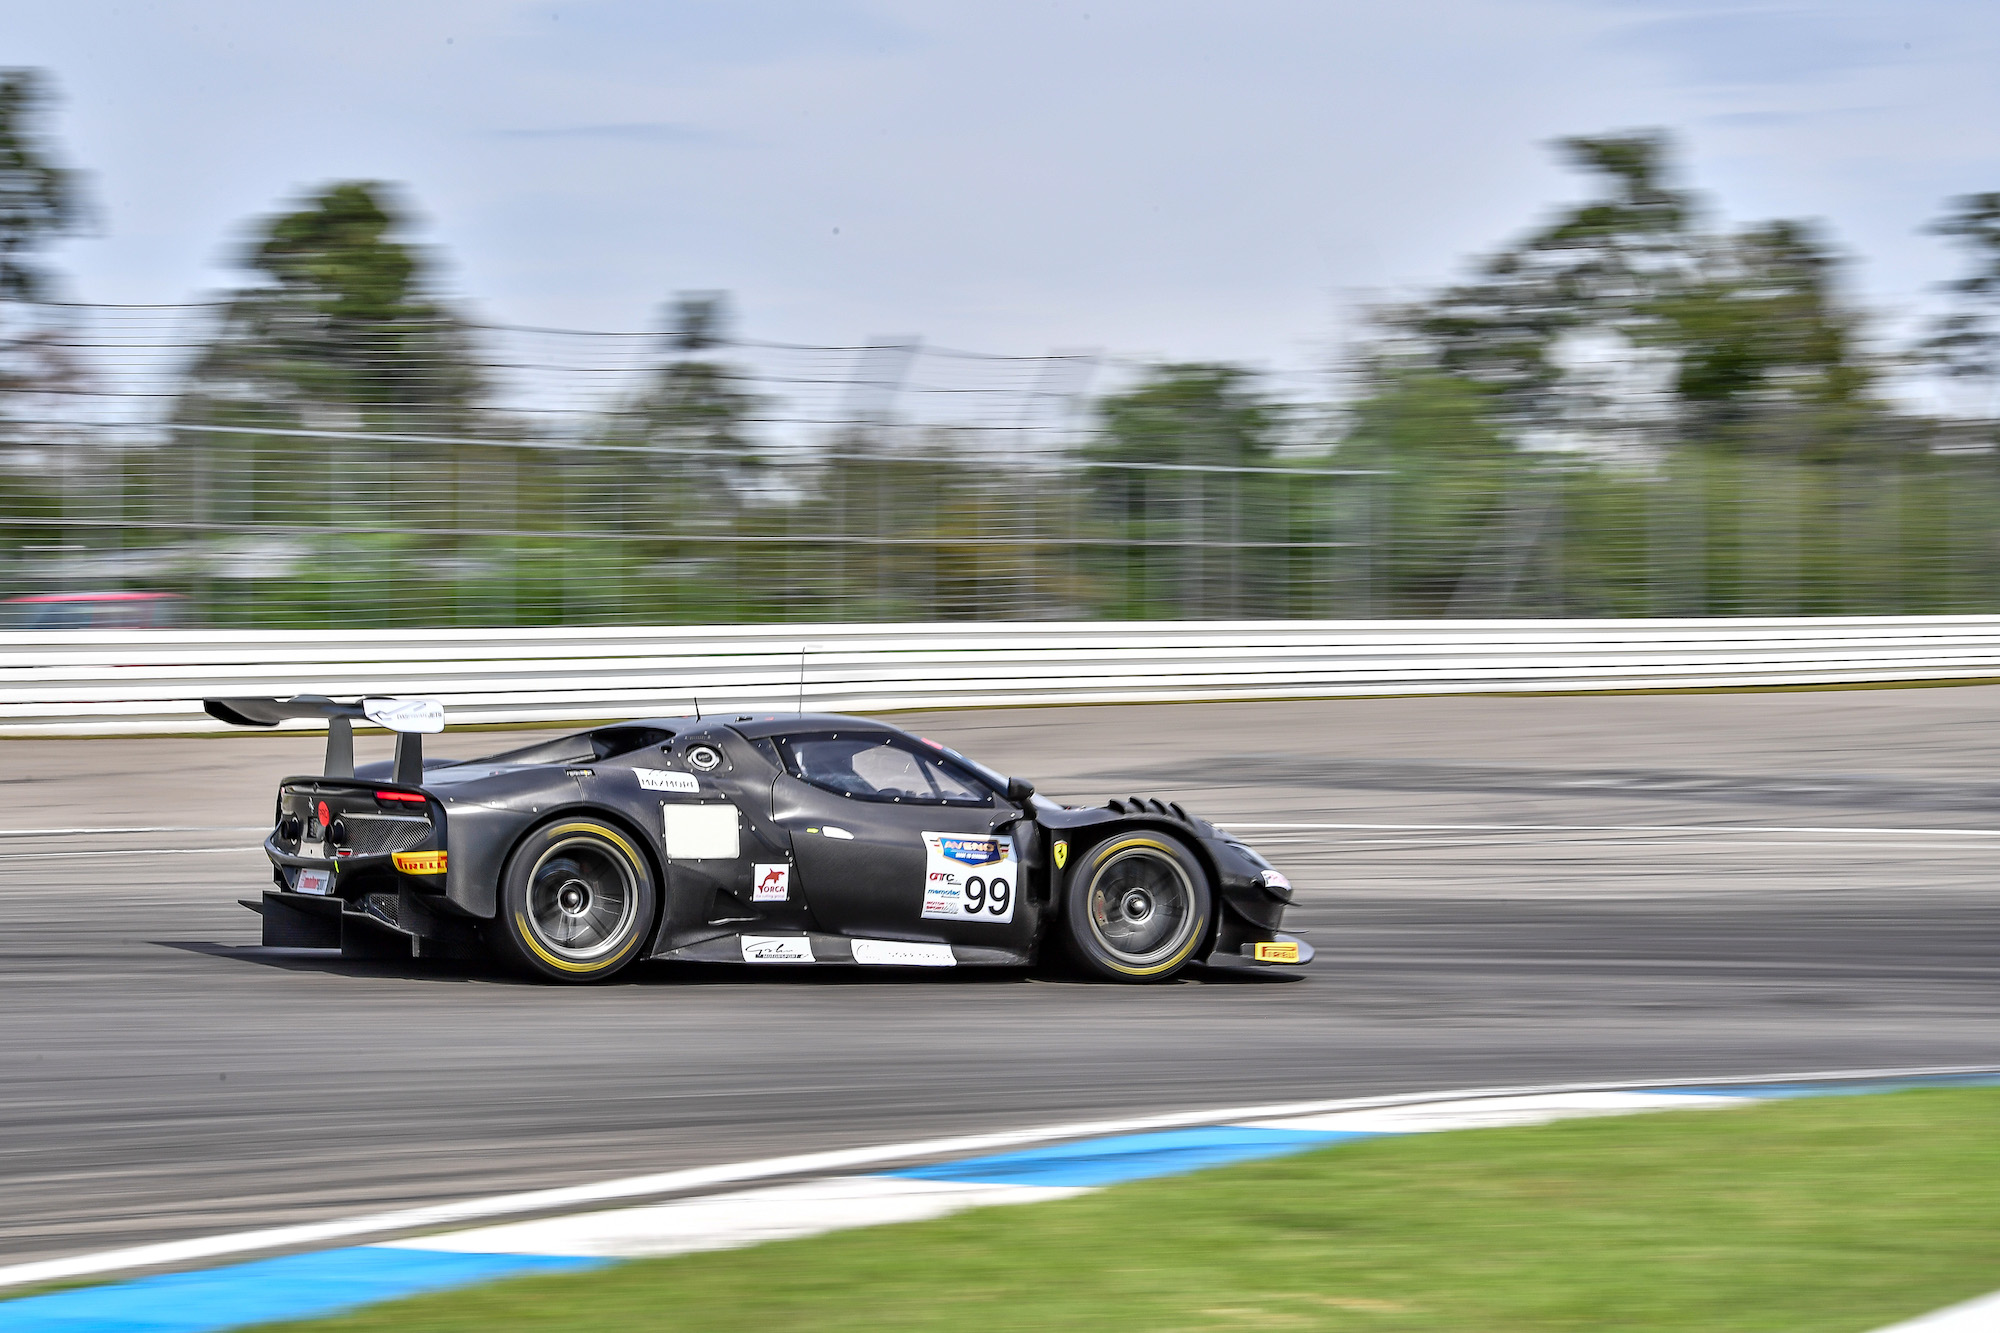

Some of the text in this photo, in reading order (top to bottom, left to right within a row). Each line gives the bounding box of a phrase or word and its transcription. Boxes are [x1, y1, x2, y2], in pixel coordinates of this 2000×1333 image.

[944, 840, 995, 852] AVENO
[763, 885, 785, 893] ORCA
[963, 875, 1011, 916] 99
